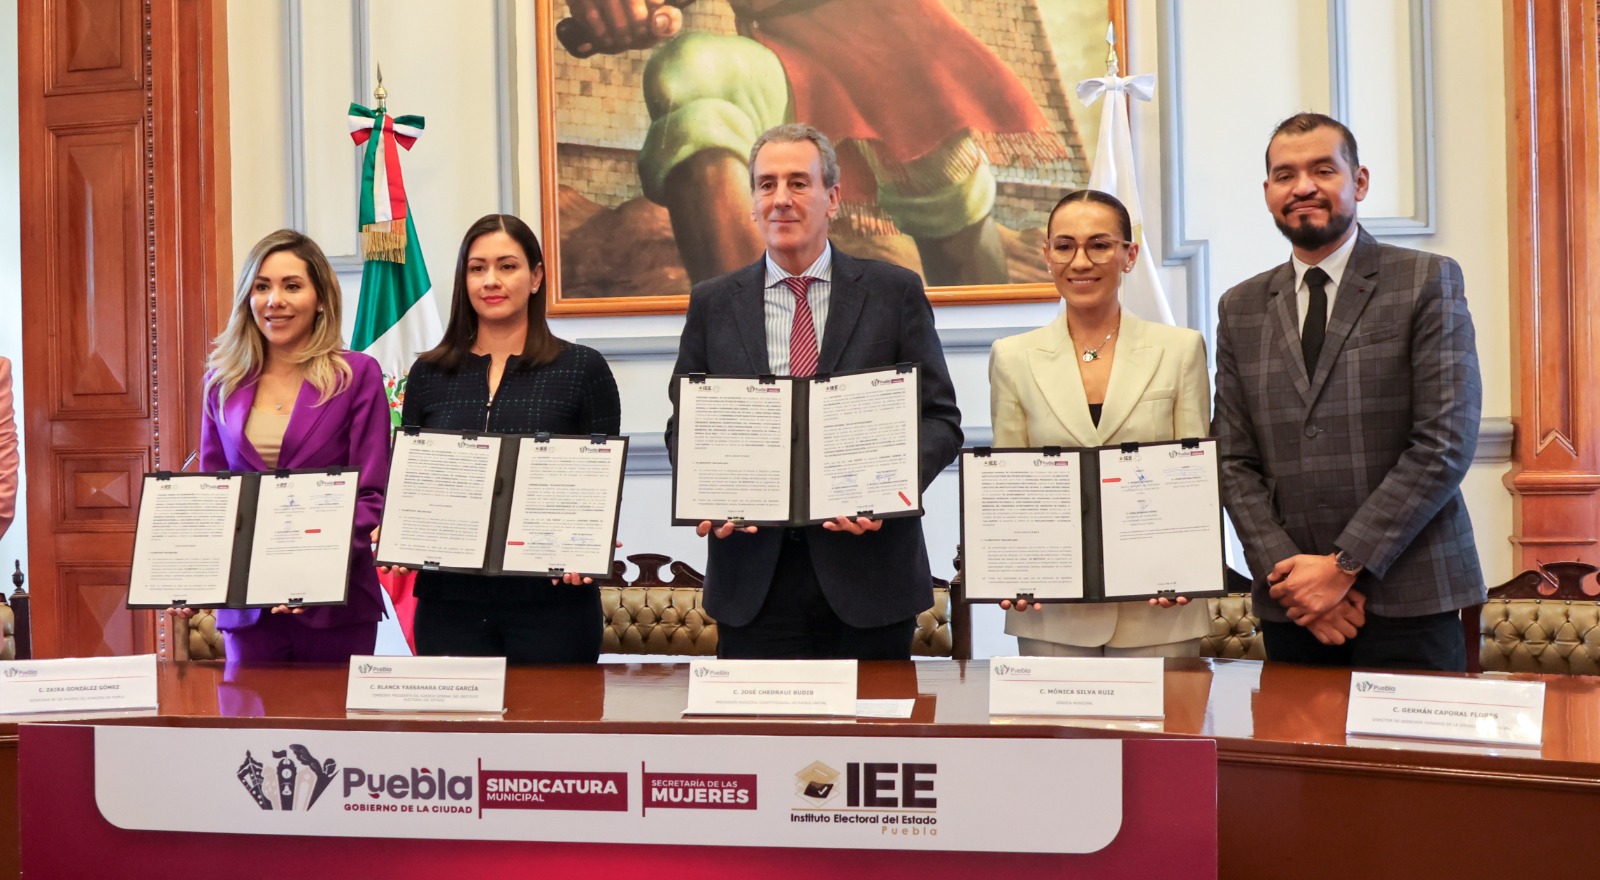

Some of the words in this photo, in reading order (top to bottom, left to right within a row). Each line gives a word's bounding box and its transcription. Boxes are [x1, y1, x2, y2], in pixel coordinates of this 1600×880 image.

[66, 684, 98, 692] GONZÁLEZ
[99, 683, 120, 691] GÓMEZ
[455, 684, 479, 692] GARCÍA
[1047, 687, 1074, 695] MÓNICA
[1401, 707, 1433, 715] GERMÁN
[1434, 709, 1468, 717] CAPORAL
[343, 767, 473, 801] Puebla
[486, 778, 618, 794] SINDICATURA
[651, 779, 706, 787] SECRETARÍA
[846, 762, 937, 808] IEE
[486, 793, 545, 802] MUNICIPAL
[651, 788, 750, 803] MUJERES
[344, 803, 398, 812] GOBIERNO
[432, 805, 473, 813] CIUDAD
[790, 813, 831, 823] Instituto
[833, 814, 879, 824] Electoral
[882, 815, 899, 824] del
[902, 815, 937, 825] Estado
[881, 826, 937, 836] Puebla
